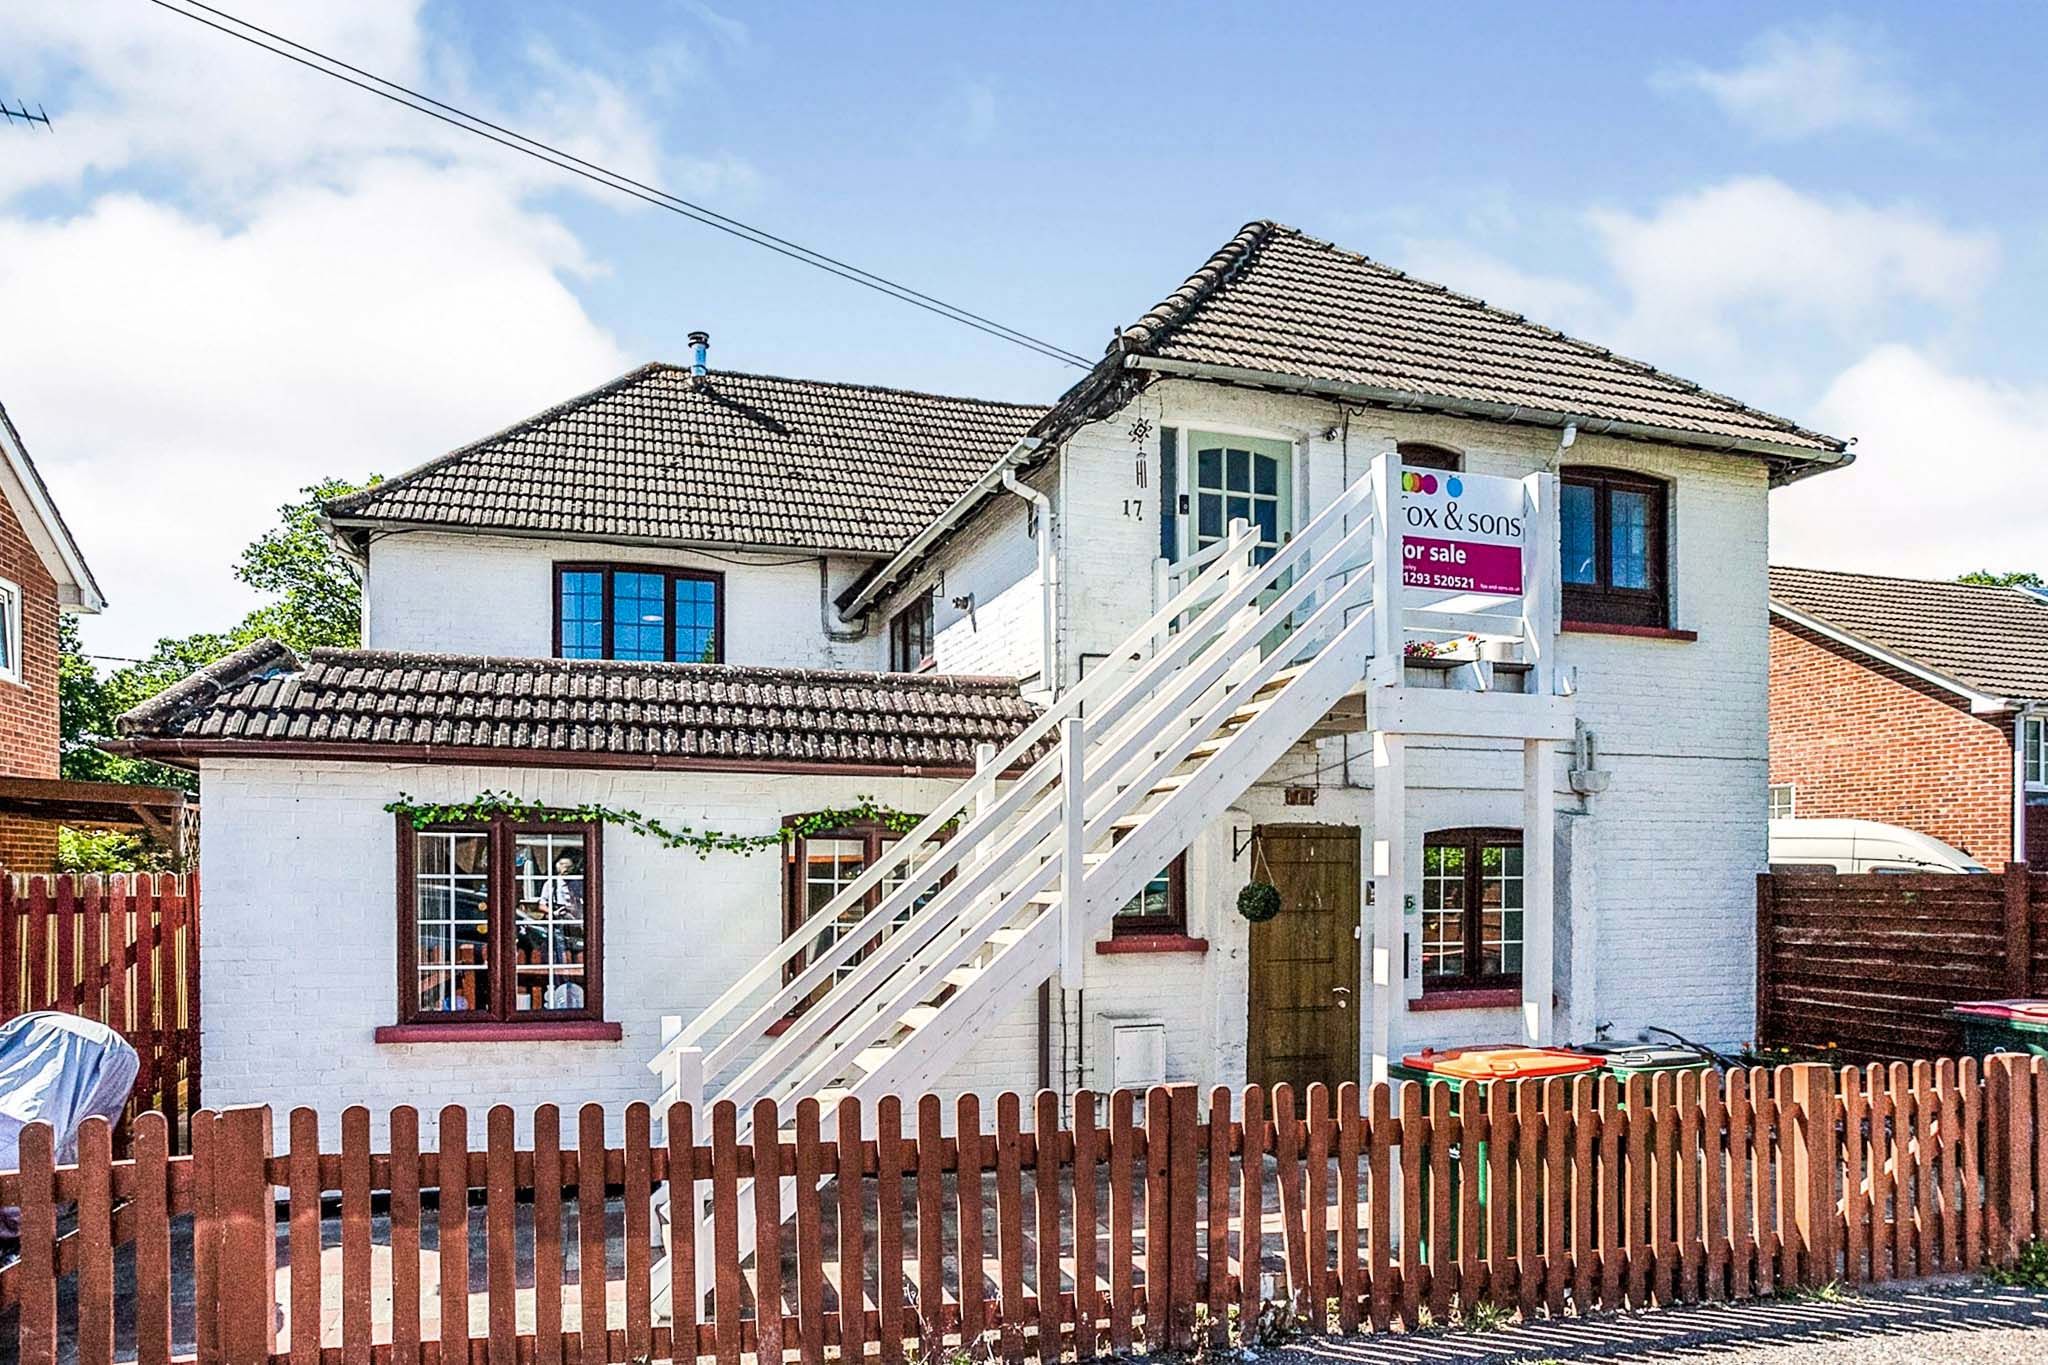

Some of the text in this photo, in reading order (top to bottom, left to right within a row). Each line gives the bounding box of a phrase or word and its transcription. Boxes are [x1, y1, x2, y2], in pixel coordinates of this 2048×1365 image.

[1122, 499, 1142, 518] 17
[1402, 496, 1521, 537] ox & sons
[1403, 543, 1466, 564] or sale
[1403, 572, 1430, 584] 1293
[1433, 575, 1475, 589] 520521
